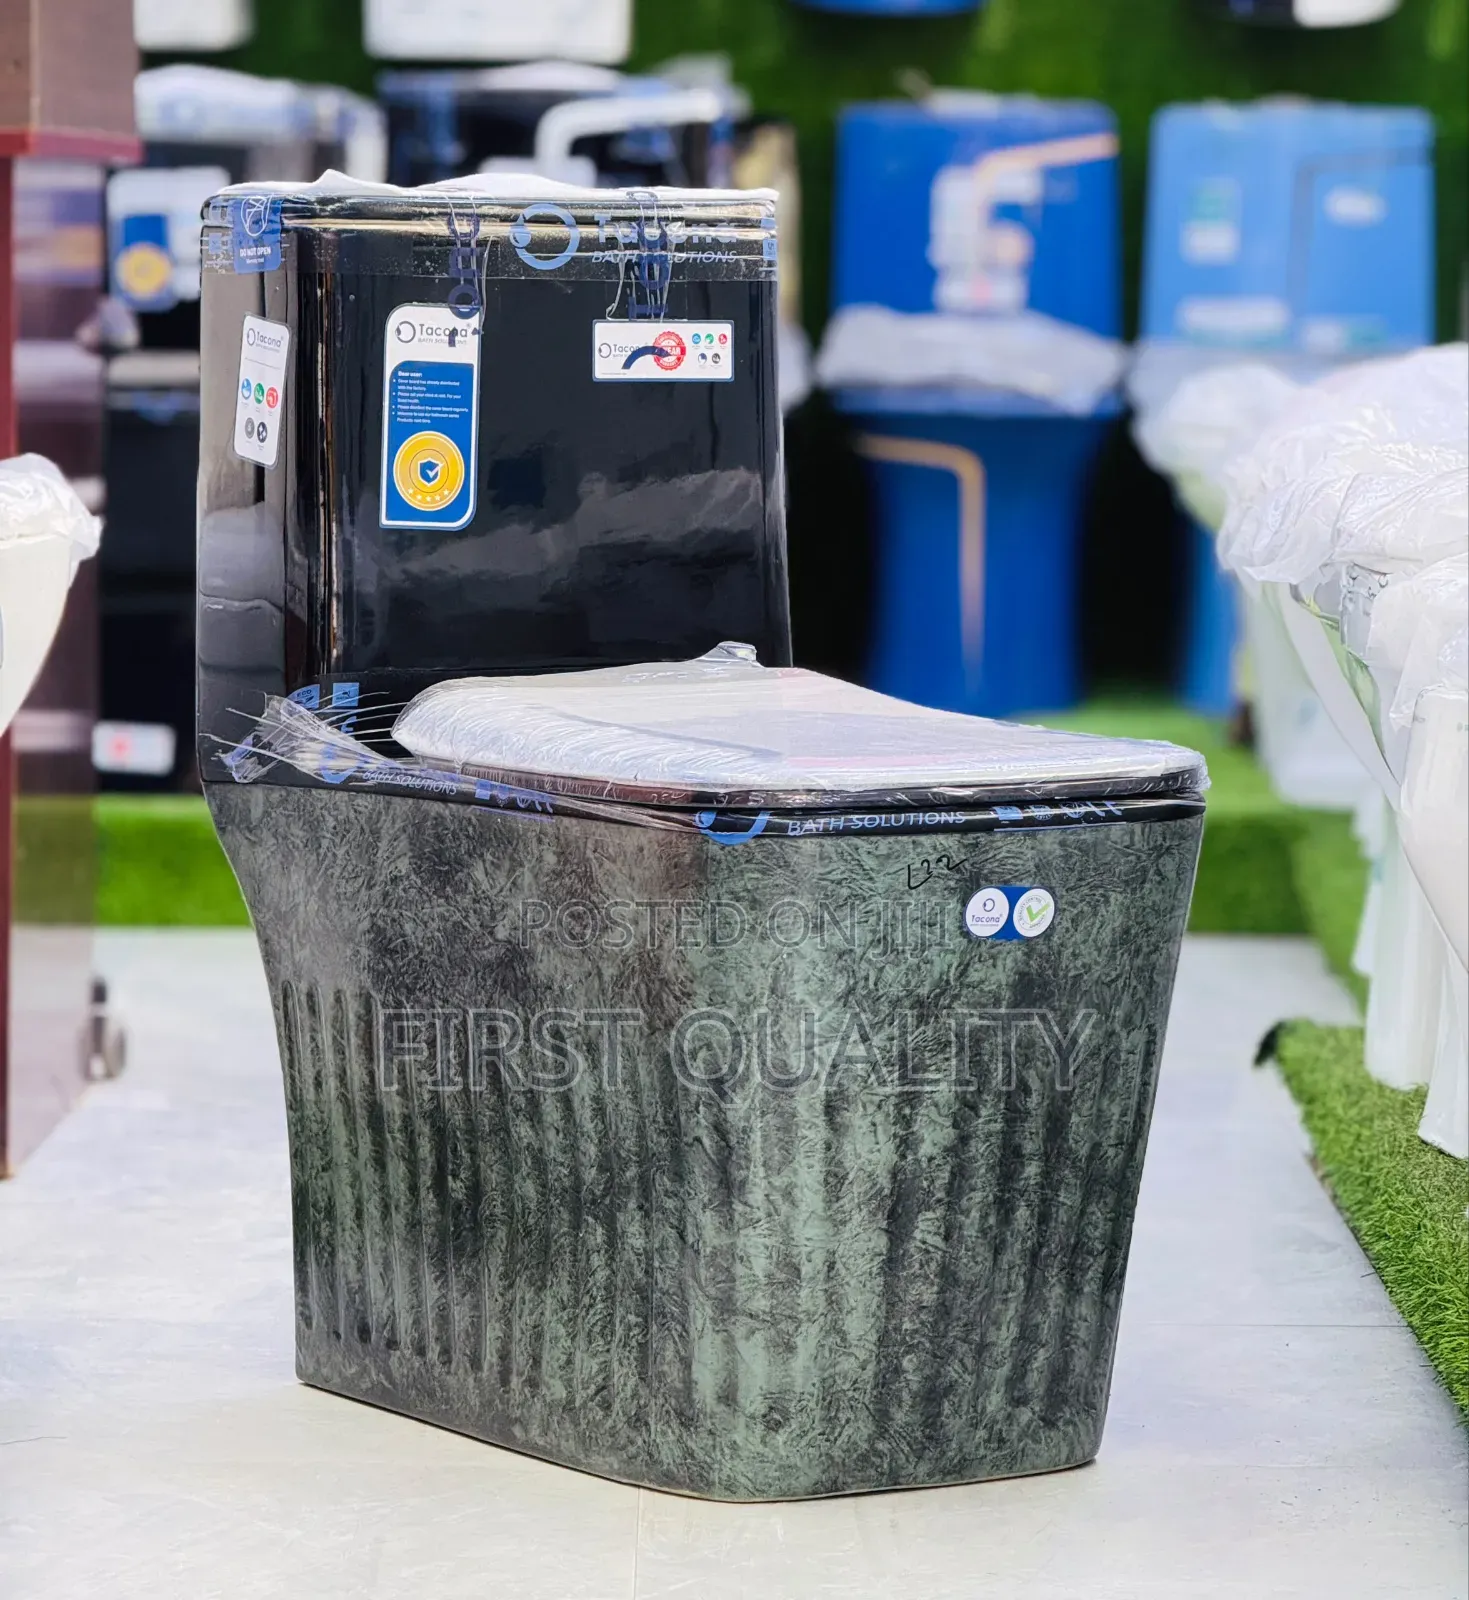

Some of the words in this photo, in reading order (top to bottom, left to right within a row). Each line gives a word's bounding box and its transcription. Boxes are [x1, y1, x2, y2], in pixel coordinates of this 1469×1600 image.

[594, 213, 737, 243] Taona
[257, 246, 272, 255] OPEN
[592, 251, 637, 263] BATH
[256, 331, 282, 348] Tacona
[296, 689, 312, 697] ECO
[362, 769, 394, 783] BATH
[395, 773, 458, 795] SOLUTIONS
[787, 817, 844, 836] BATH
[850, 811, 967, 829] SOLUTIONS
[971, 915, 1000, 923] Tacona
